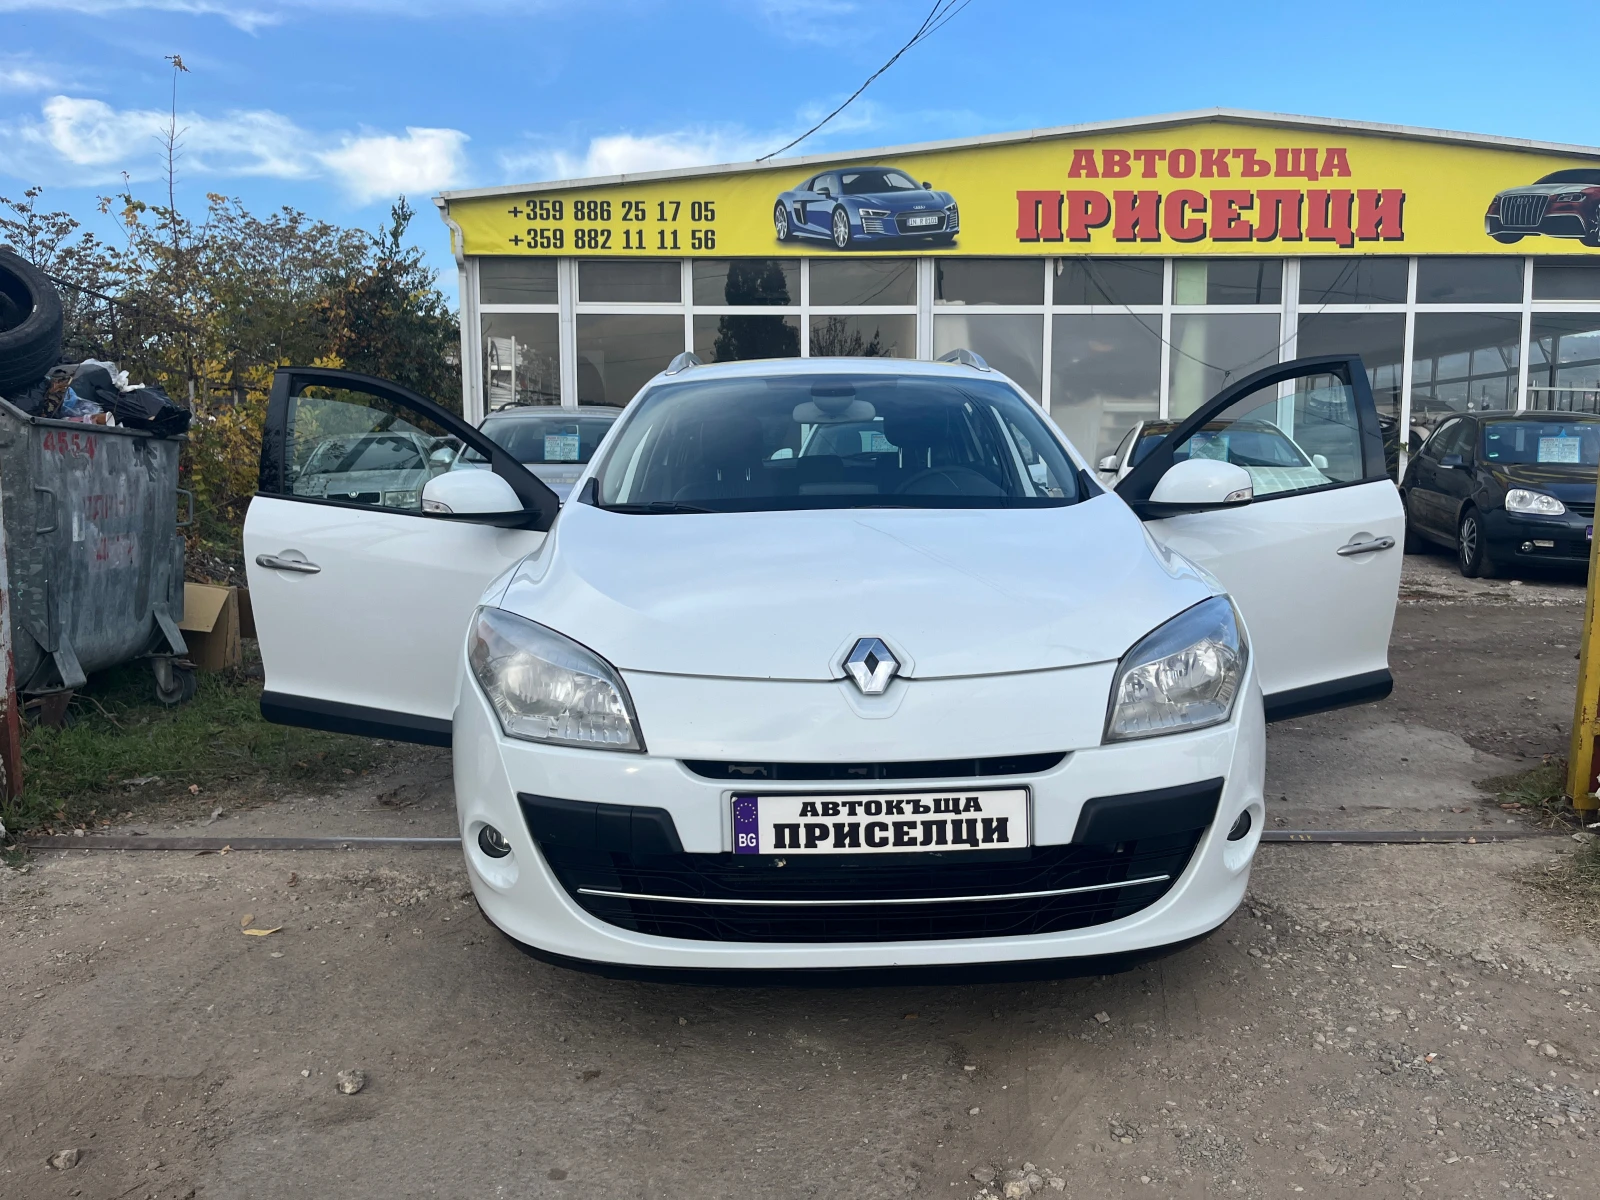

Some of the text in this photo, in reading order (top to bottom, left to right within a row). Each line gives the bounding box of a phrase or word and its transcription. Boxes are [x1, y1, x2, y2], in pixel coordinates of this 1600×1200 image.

[1068, 147, 1352, 182] АВТОКЪЩА
[507, 200, 716, 222] +359 886 25 17 05
[1015, 189, 1405, 248] ПРИСЕЛЦИ
[508, 228, 716, 250] +359 882 11 11 56
[799, 796, 983, 817] АВТОКЪЩА
[738, 833, 757, 847] BG
[773, 817, 1009, 848] ПРИСЕЛЦИ
